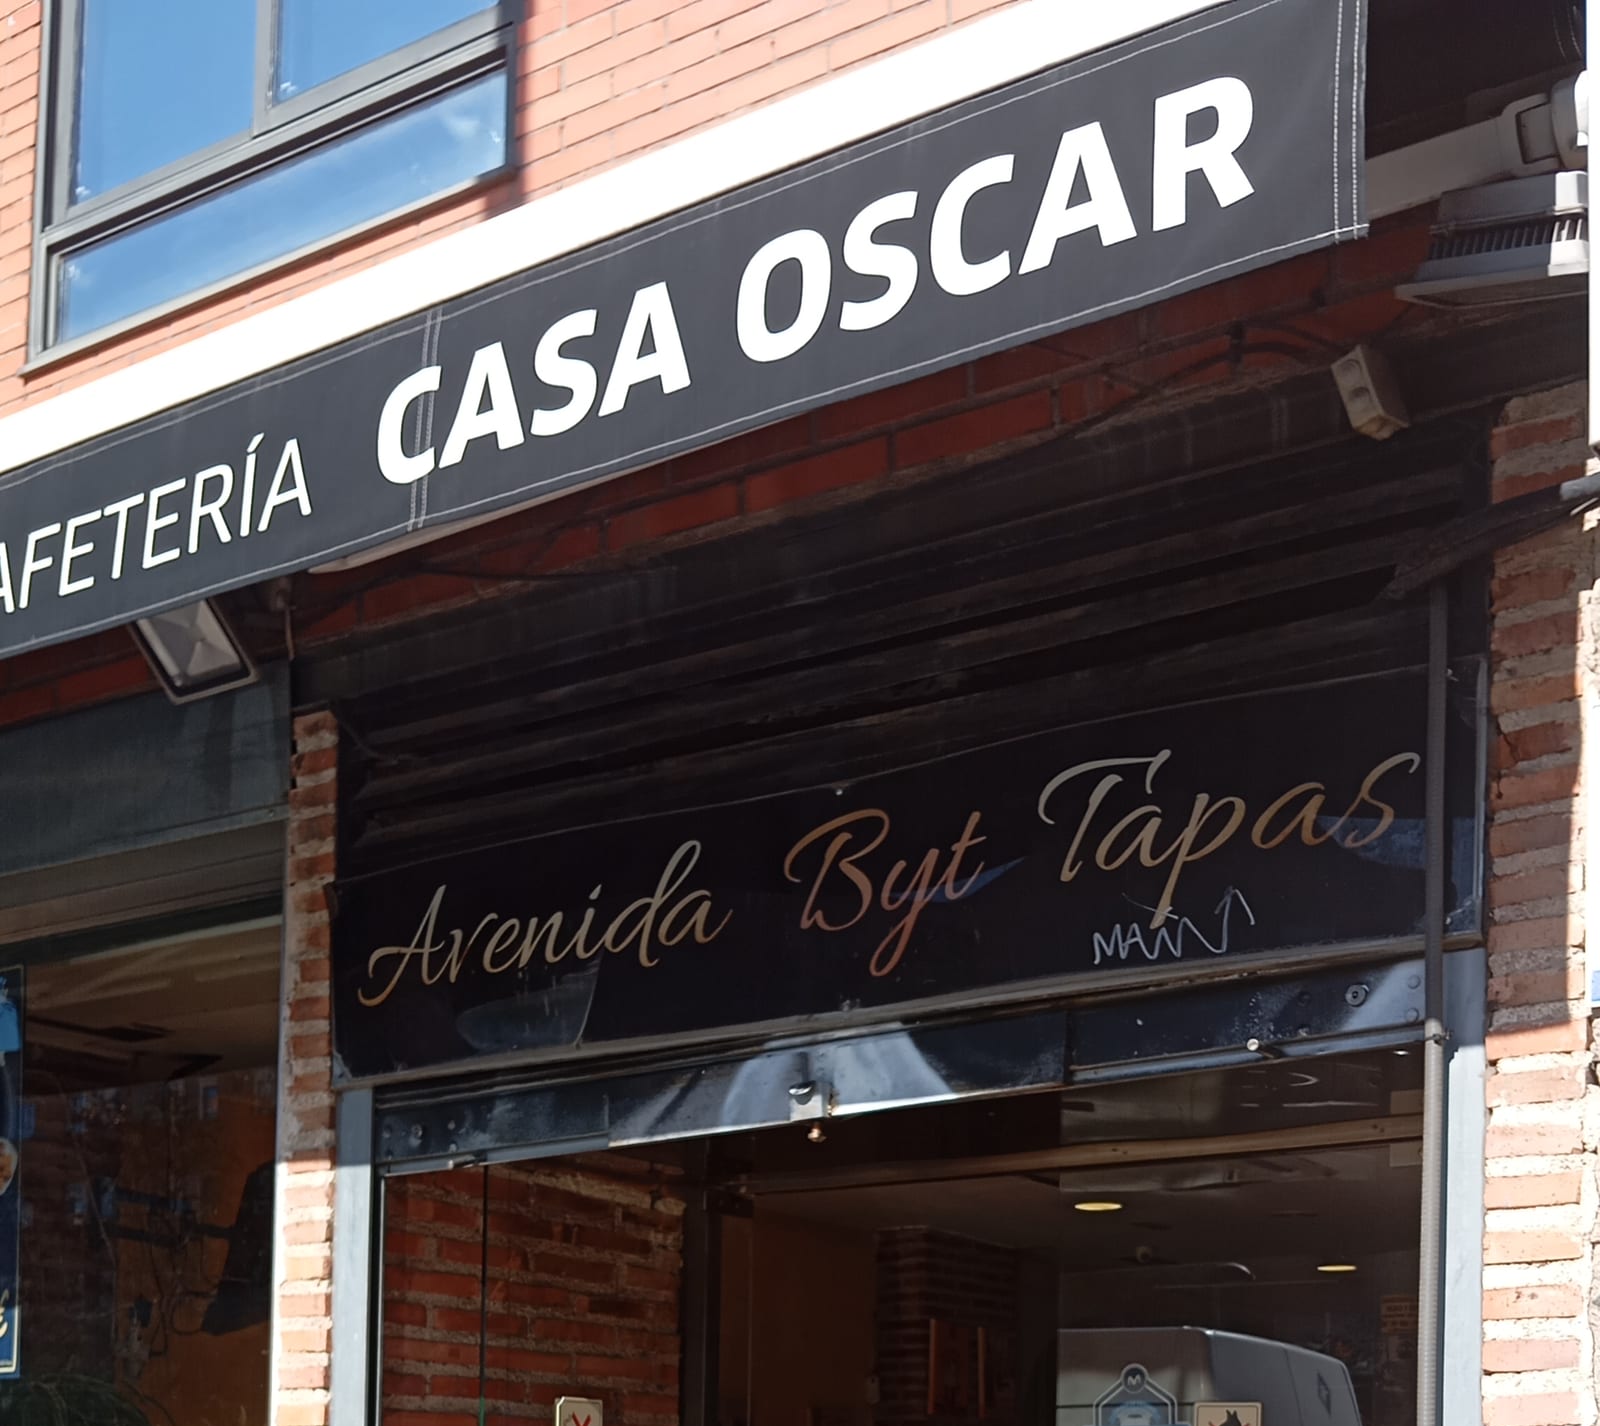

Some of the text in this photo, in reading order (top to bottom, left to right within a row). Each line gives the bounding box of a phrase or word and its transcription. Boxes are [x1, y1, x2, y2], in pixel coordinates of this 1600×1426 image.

[0, 76, 1255, 613] FETERÍA CASA OSCAR
[357, 748, 1420, 1006] Avenida Byt Tapas
